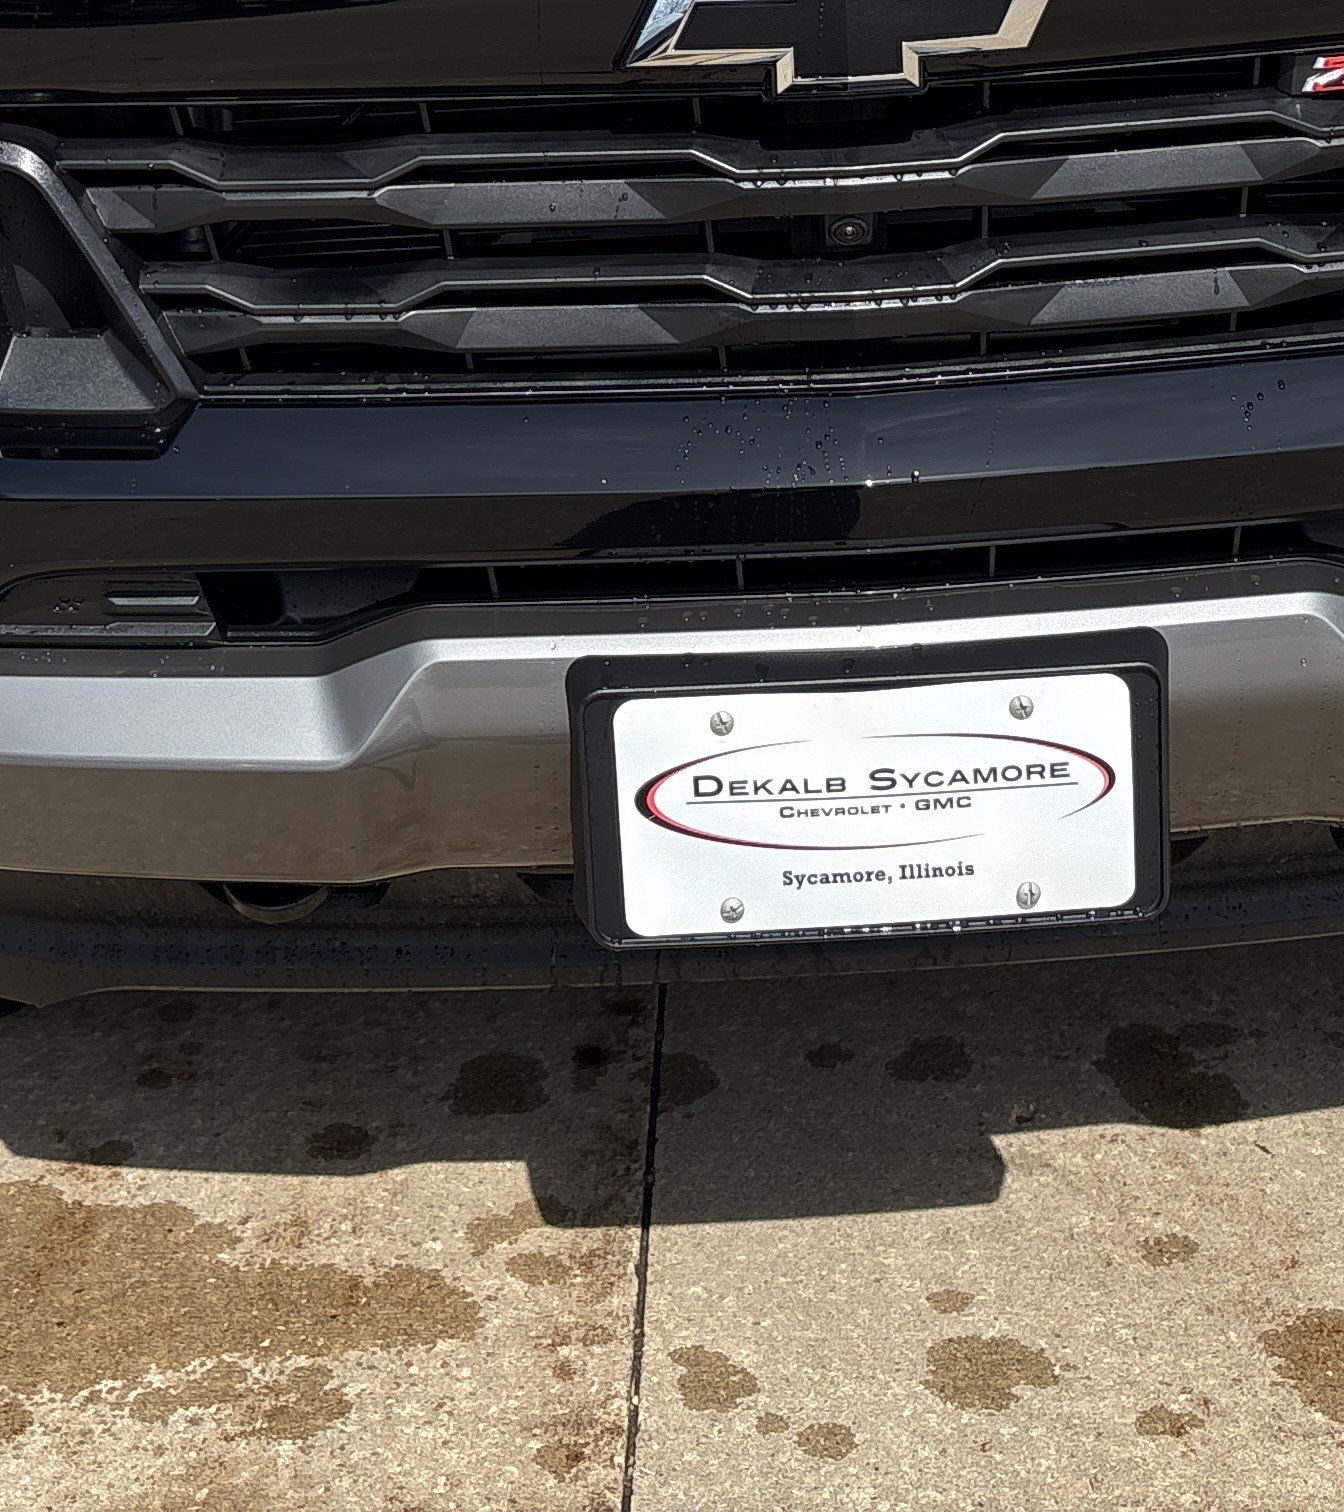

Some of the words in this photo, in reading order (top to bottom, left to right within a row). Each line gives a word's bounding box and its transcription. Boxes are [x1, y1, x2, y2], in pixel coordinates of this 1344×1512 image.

[692, 774, 847, 798] DEKALB
[868, 761, 1072, 792] SYCAMORE
[778, 804, 892, 819] CHEVROLET
[914, 795, 973, 812] GMC
[782, 869, 893, 890] Sycamore,
[898, 860, 975, 881] Illinois
